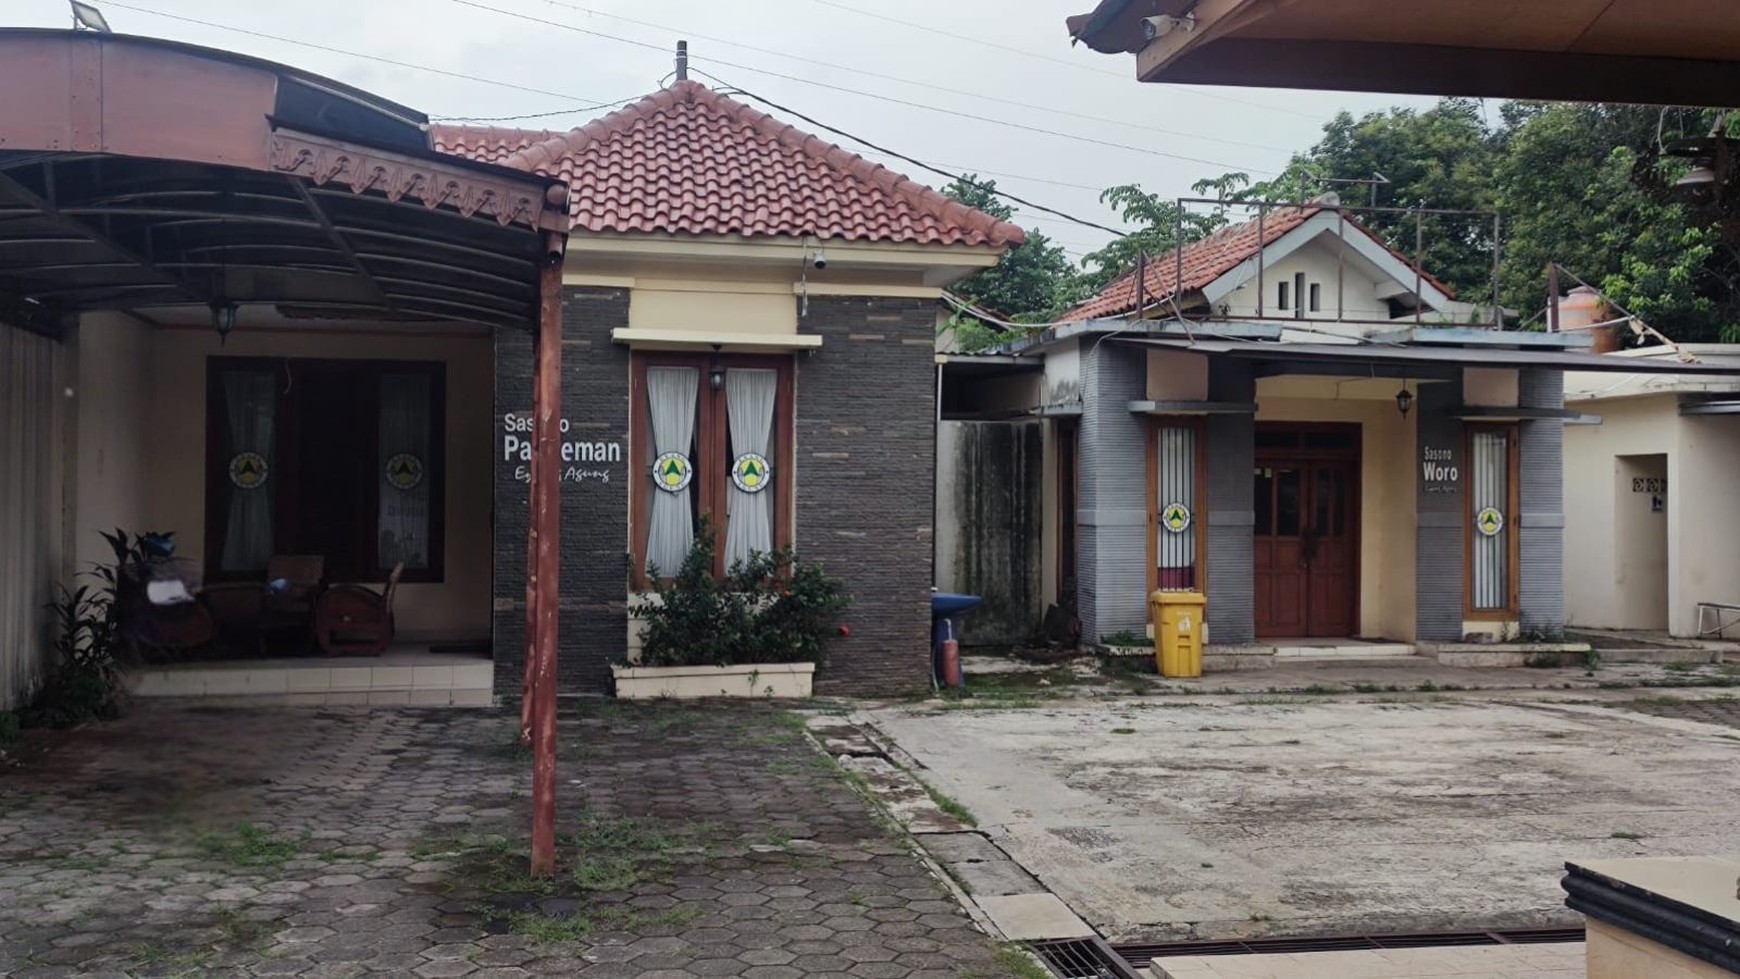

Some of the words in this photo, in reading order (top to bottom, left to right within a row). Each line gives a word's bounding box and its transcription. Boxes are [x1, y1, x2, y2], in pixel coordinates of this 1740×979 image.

[504, 413, 570, 433] Saso
[504, 435, 621, 461] Paeman
[564, 466, 610, 483] Agung
[1423, 461, 1458, 481] Woro
